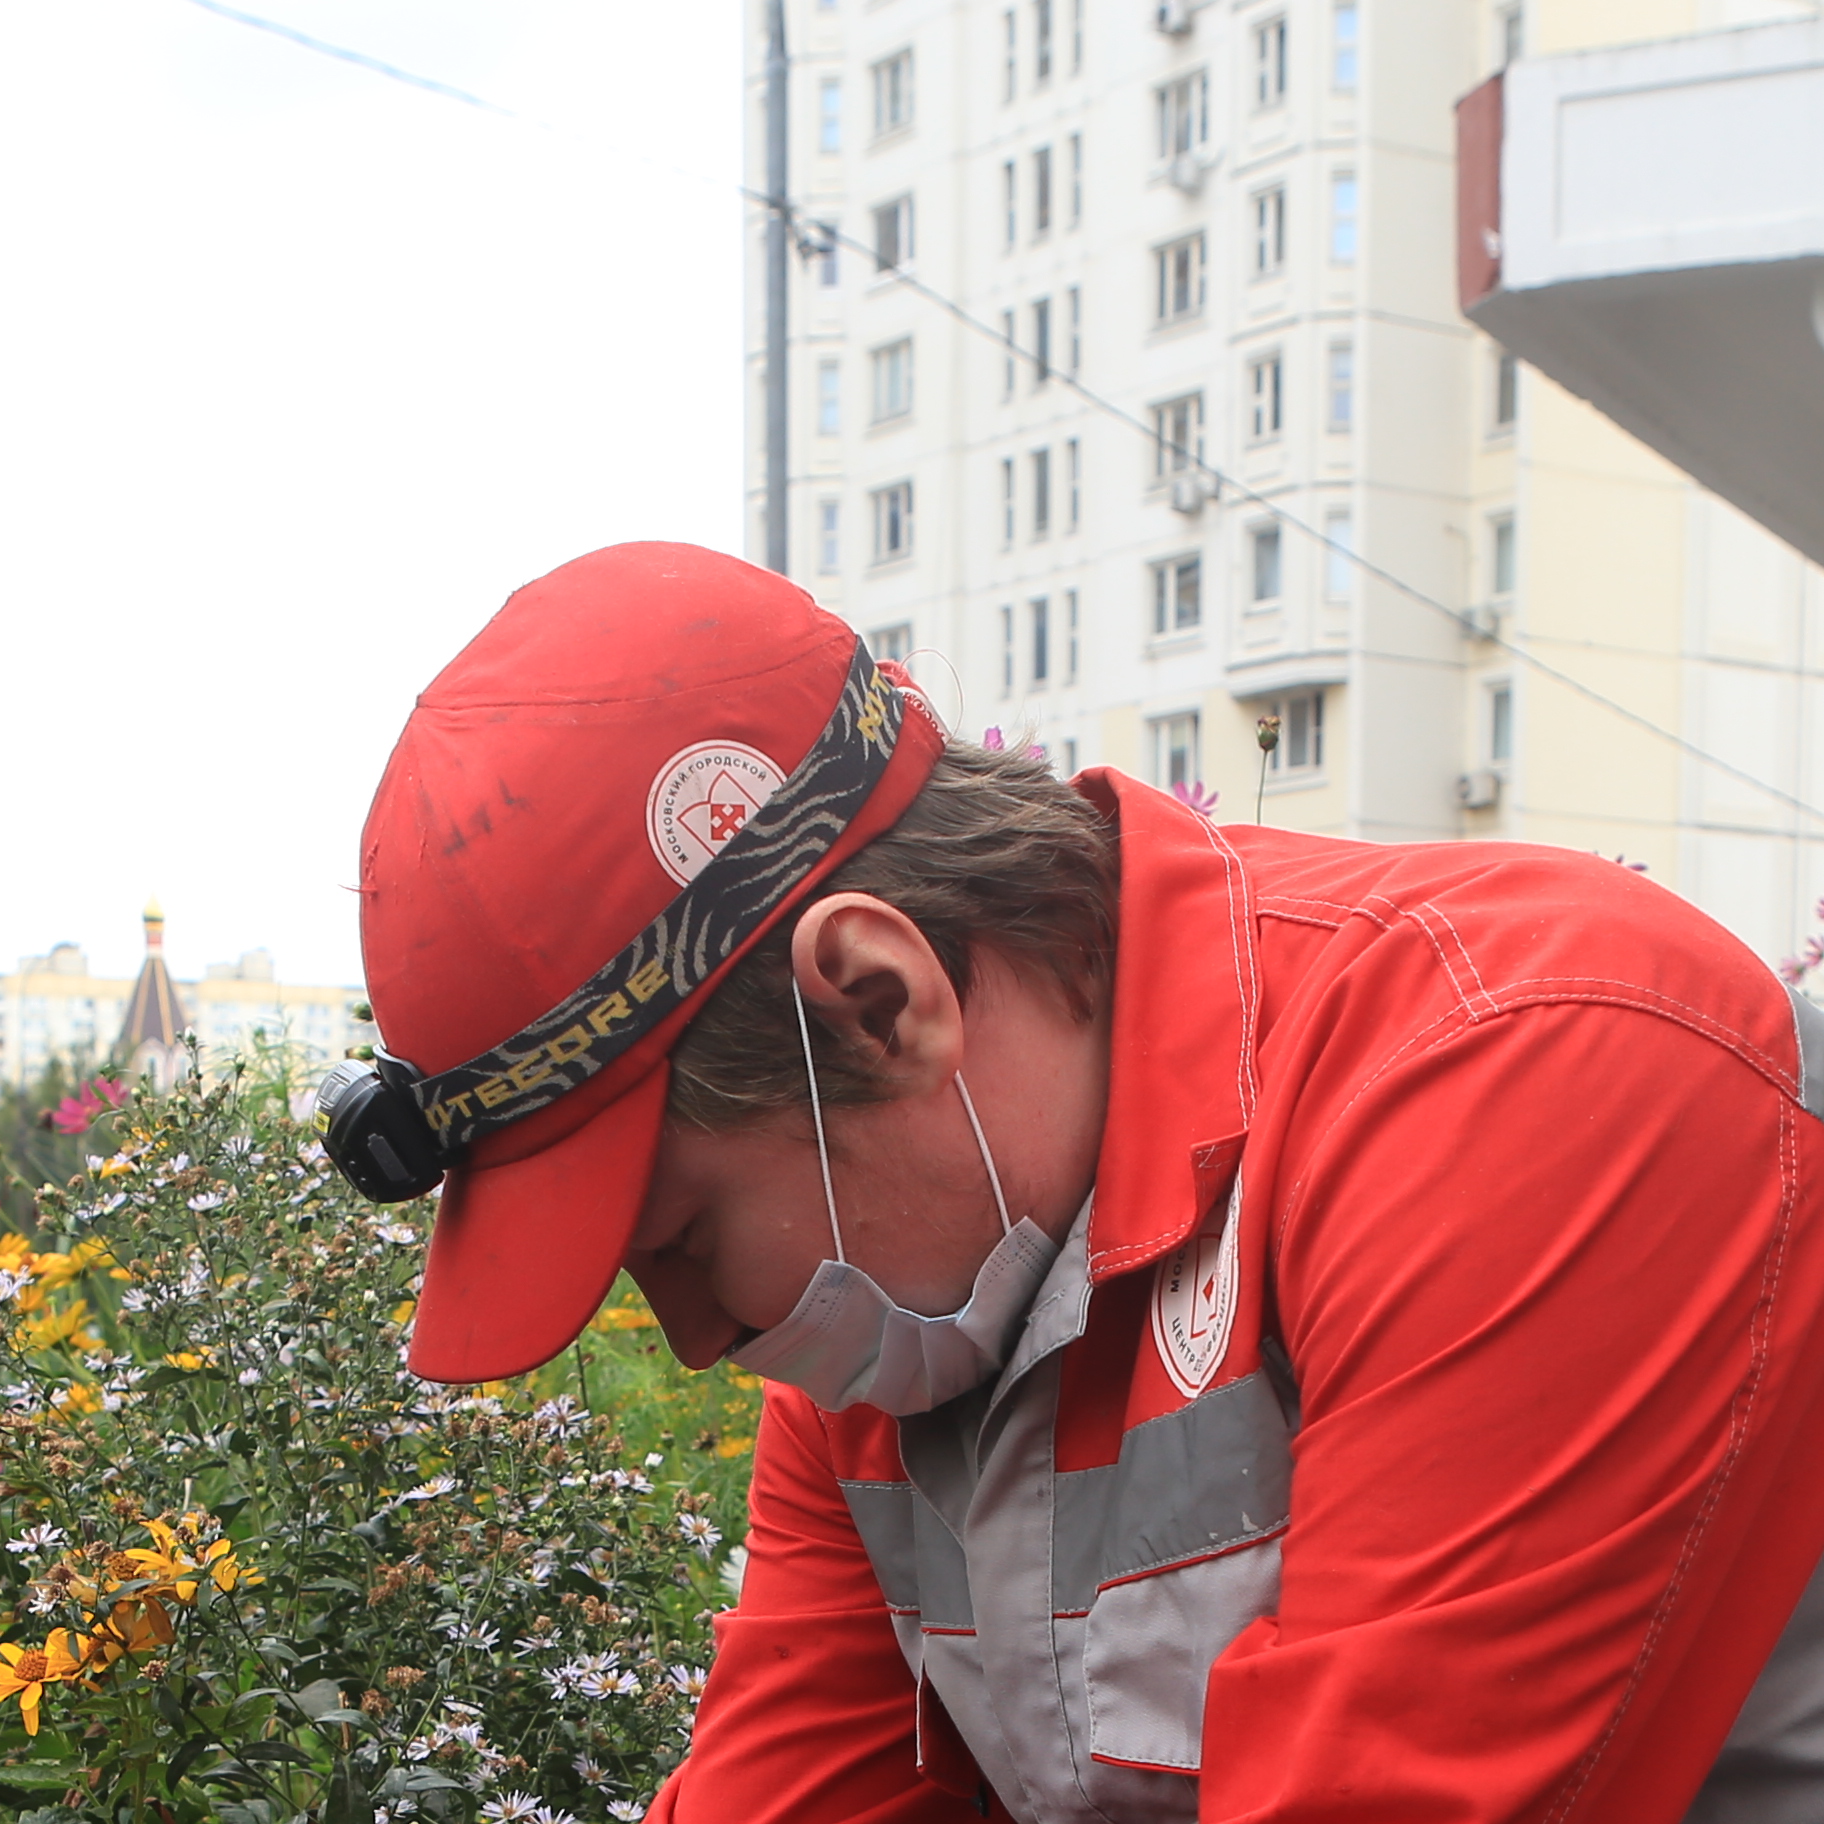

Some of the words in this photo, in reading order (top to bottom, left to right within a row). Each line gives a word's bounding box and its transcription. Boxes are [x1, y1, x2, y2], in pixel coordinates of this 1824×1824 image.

[663, 771, 689, 864] МОСКОВСКИЙ
[687, 756, 768, 782] ГОРОДСКОЙ
[1172, 1316, 1195, 1366] ЦЕНТР
